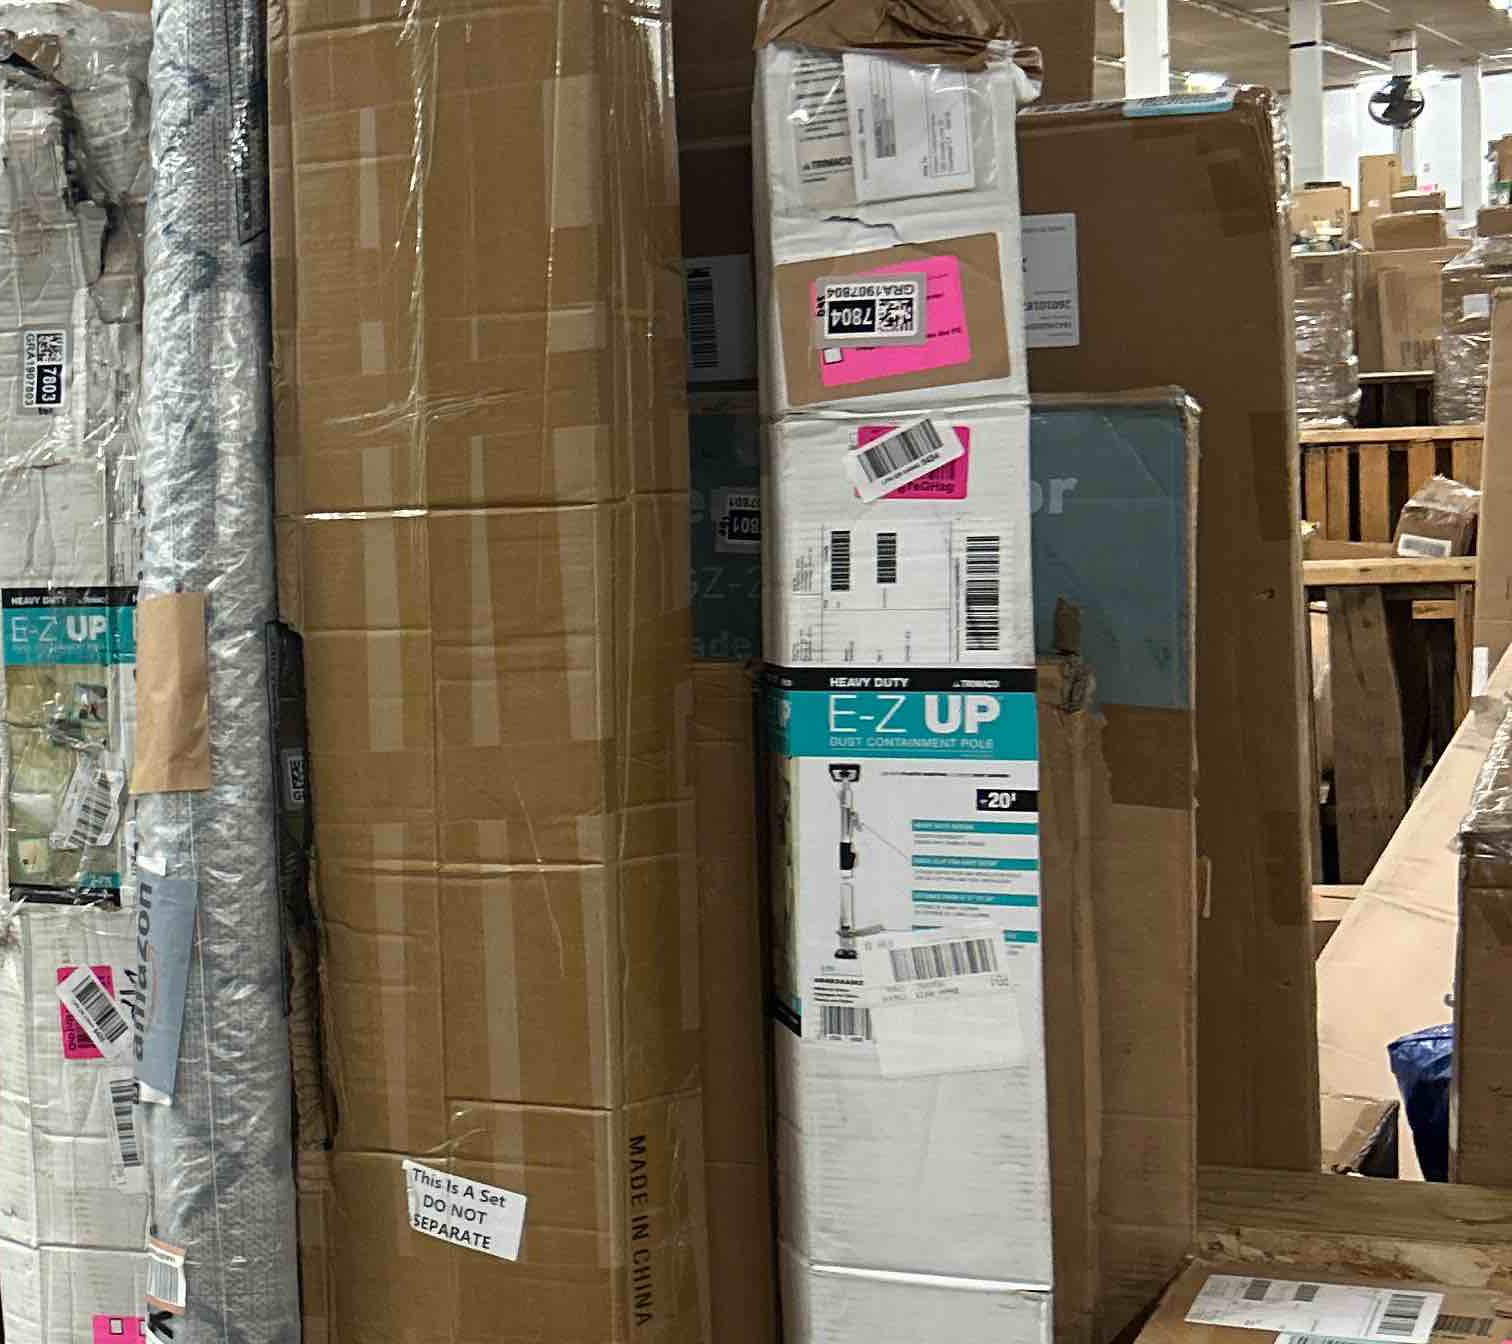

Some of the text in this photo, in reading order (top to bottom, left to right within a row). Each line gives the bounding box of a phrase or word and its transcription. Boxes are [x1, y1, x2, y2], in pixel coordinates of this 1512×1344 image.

[830, 307, 874, 327] 7804
[41, 366, 58, 403] 7803
[66, 615, 108, 642] UP
[829, 676, 910, 689] HEAVY DUTY
[828, 694, 1002, 735] E-Z UP
[828, 736, 863, 748] DUST
[865, 737, 956, 749] CONTAINMENT
[412, 1167, 507, 1208] This Is A Set
[423, 1194, 488, 1225] DO NOT
[413, 1212, 492, 1250] SEPARATE
[628, 1135, 654, 1327] MADE IN CHINA
